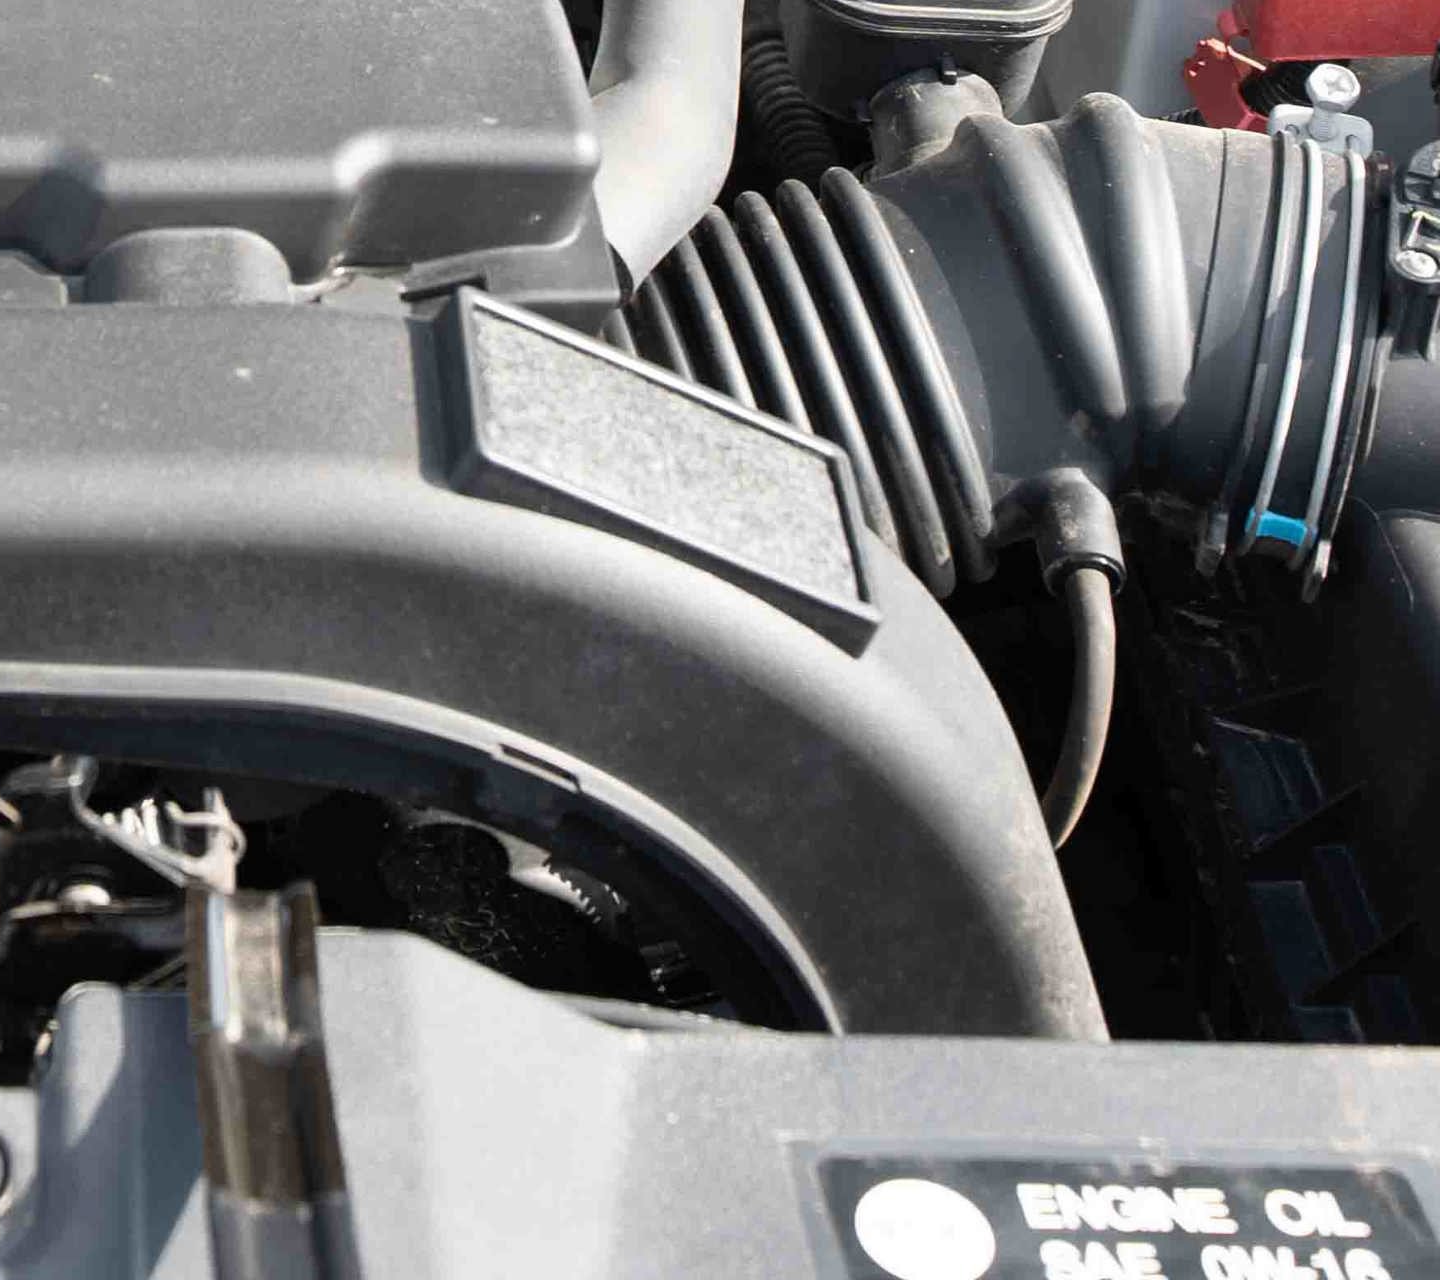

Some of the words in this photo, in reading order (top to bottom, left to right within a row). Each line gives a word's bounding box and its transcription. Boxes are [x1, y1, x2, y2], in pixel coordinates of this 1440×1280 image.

[1016, 1183, 1238, 1235] ENGINE
[1263, 1188, 1372, 1238] OIL
[1039, 1239, 1168, 1280] SAE
